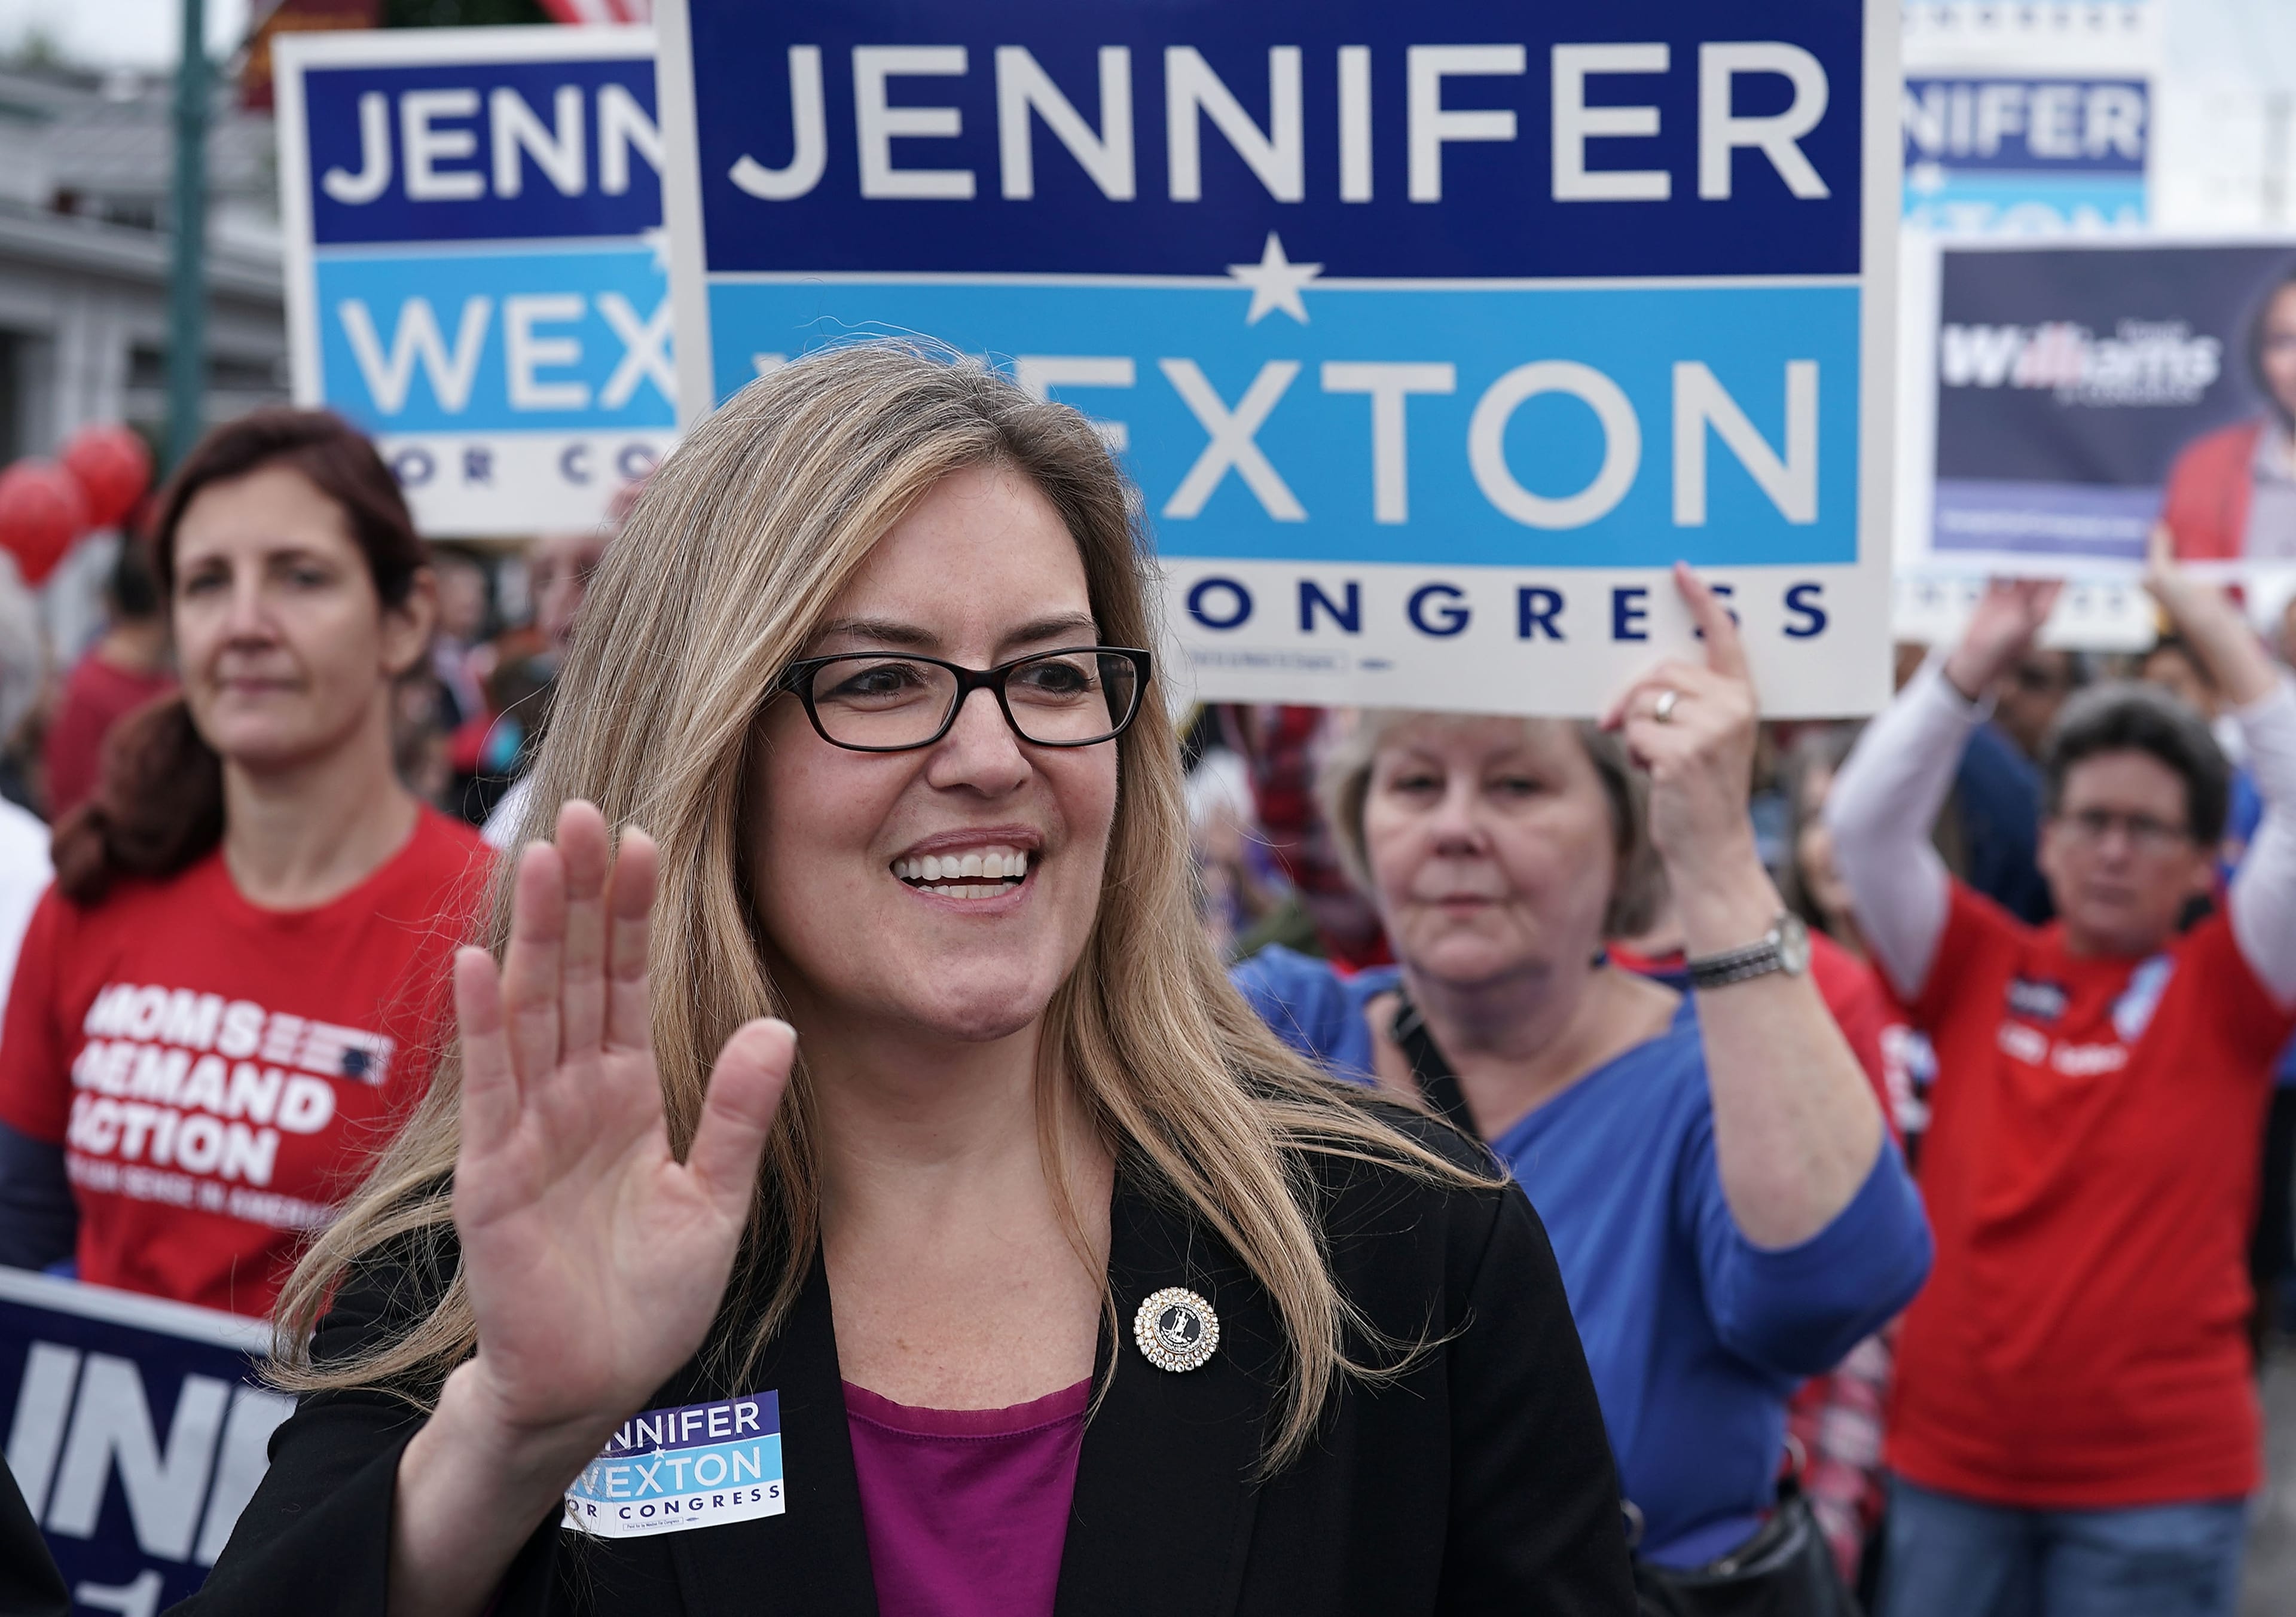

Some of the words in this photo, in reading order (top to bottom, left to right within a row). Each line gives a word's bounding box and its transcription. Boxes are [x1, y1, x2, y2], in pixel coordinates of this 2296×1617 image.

[321, 84, 664, 205] JENN
[728, 40, 1831, 203] JENNIFER
[337, 291, 677, 416] WEX
[752, 354, 1818, 530] XTON
[619, 1485, 780, 1520] CONGRESS
